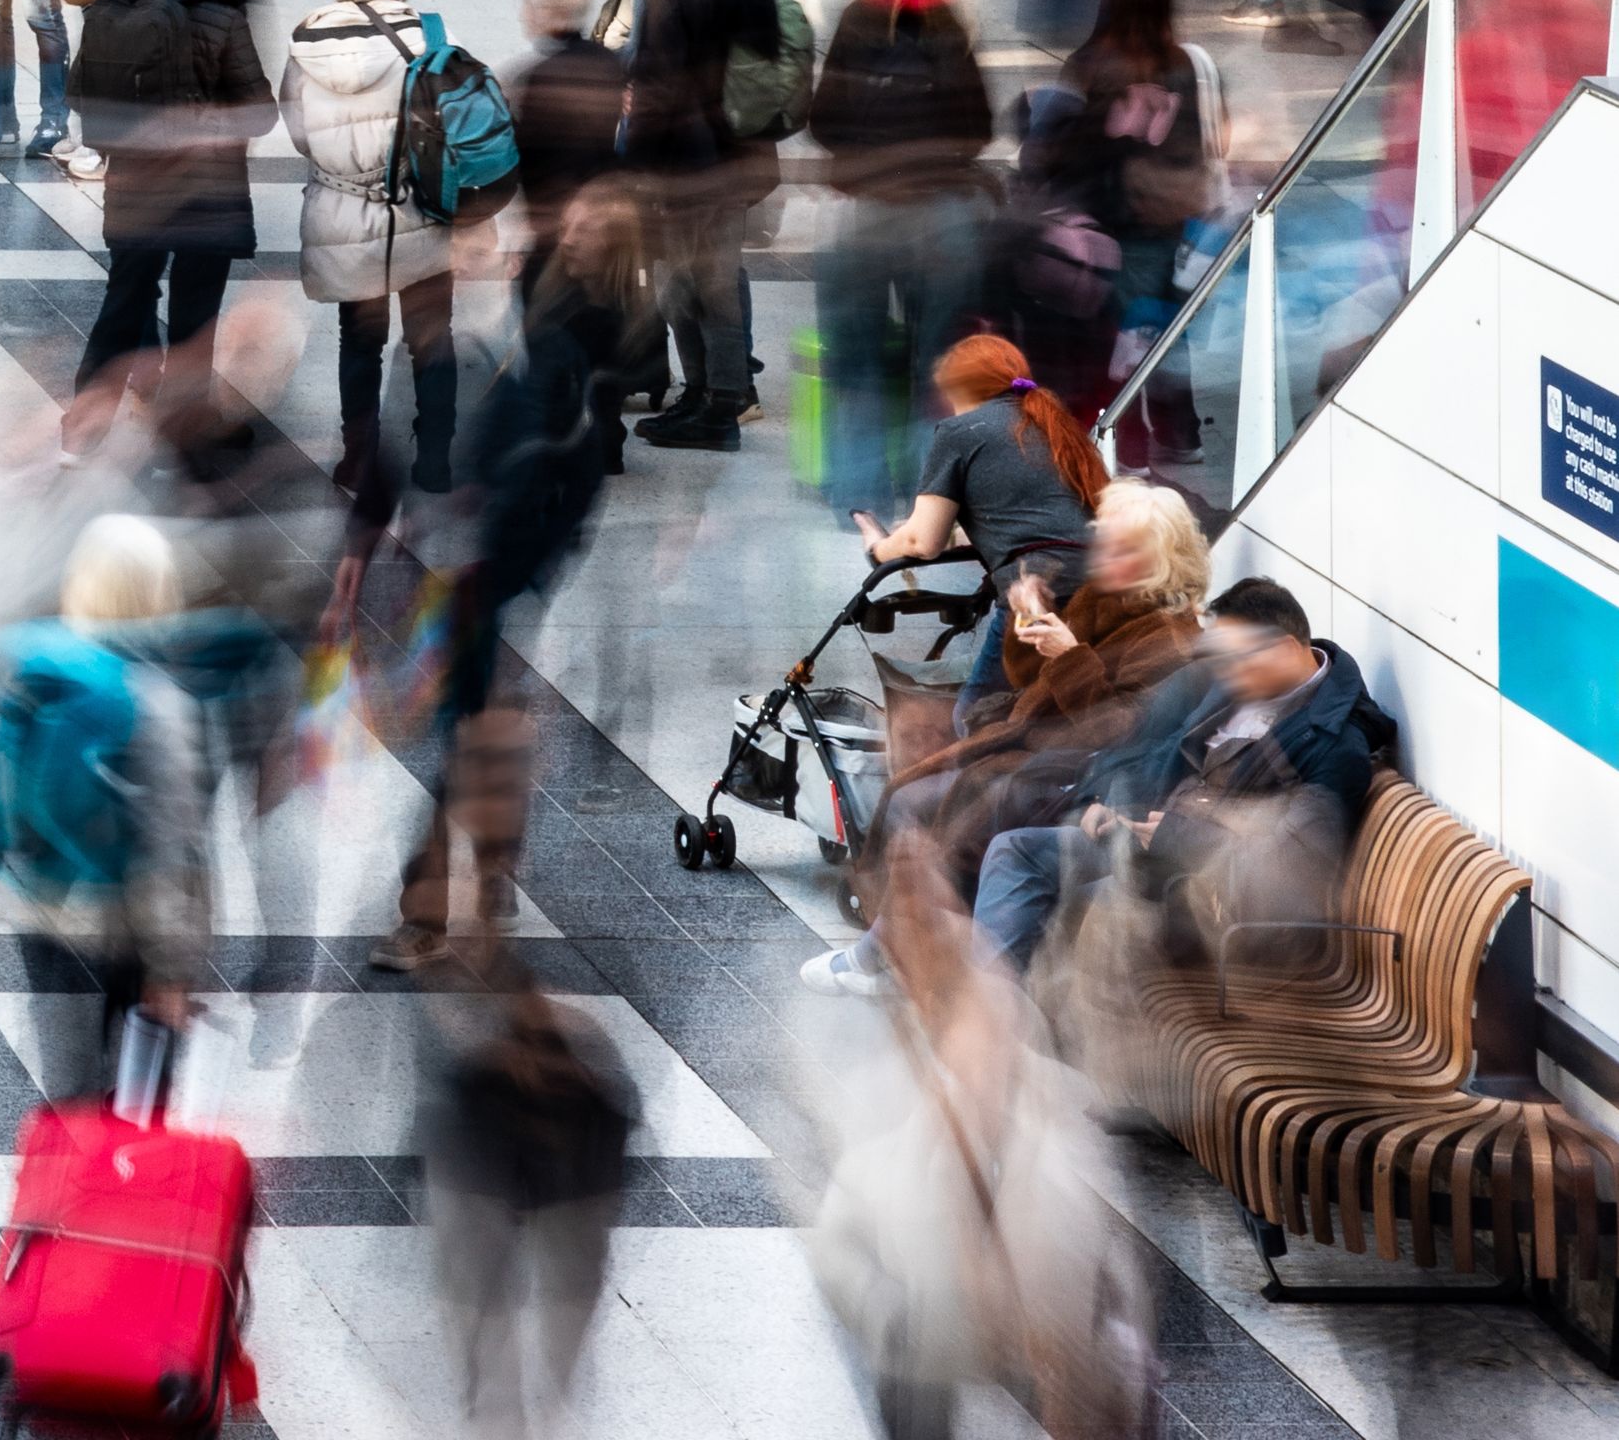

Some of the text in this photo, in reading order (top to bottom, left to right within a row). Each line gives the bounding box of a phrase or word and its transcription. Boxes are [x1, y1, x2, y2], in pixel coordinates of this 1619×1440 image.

[1566, 393, 1617, 439] You will not be
[1566, 422, 1617, 465] charged to use
[1566, 450, 1578, 472] any
[1580, 457, 1595, 478] cash
[1566, 474, 1613, 514] at this station
